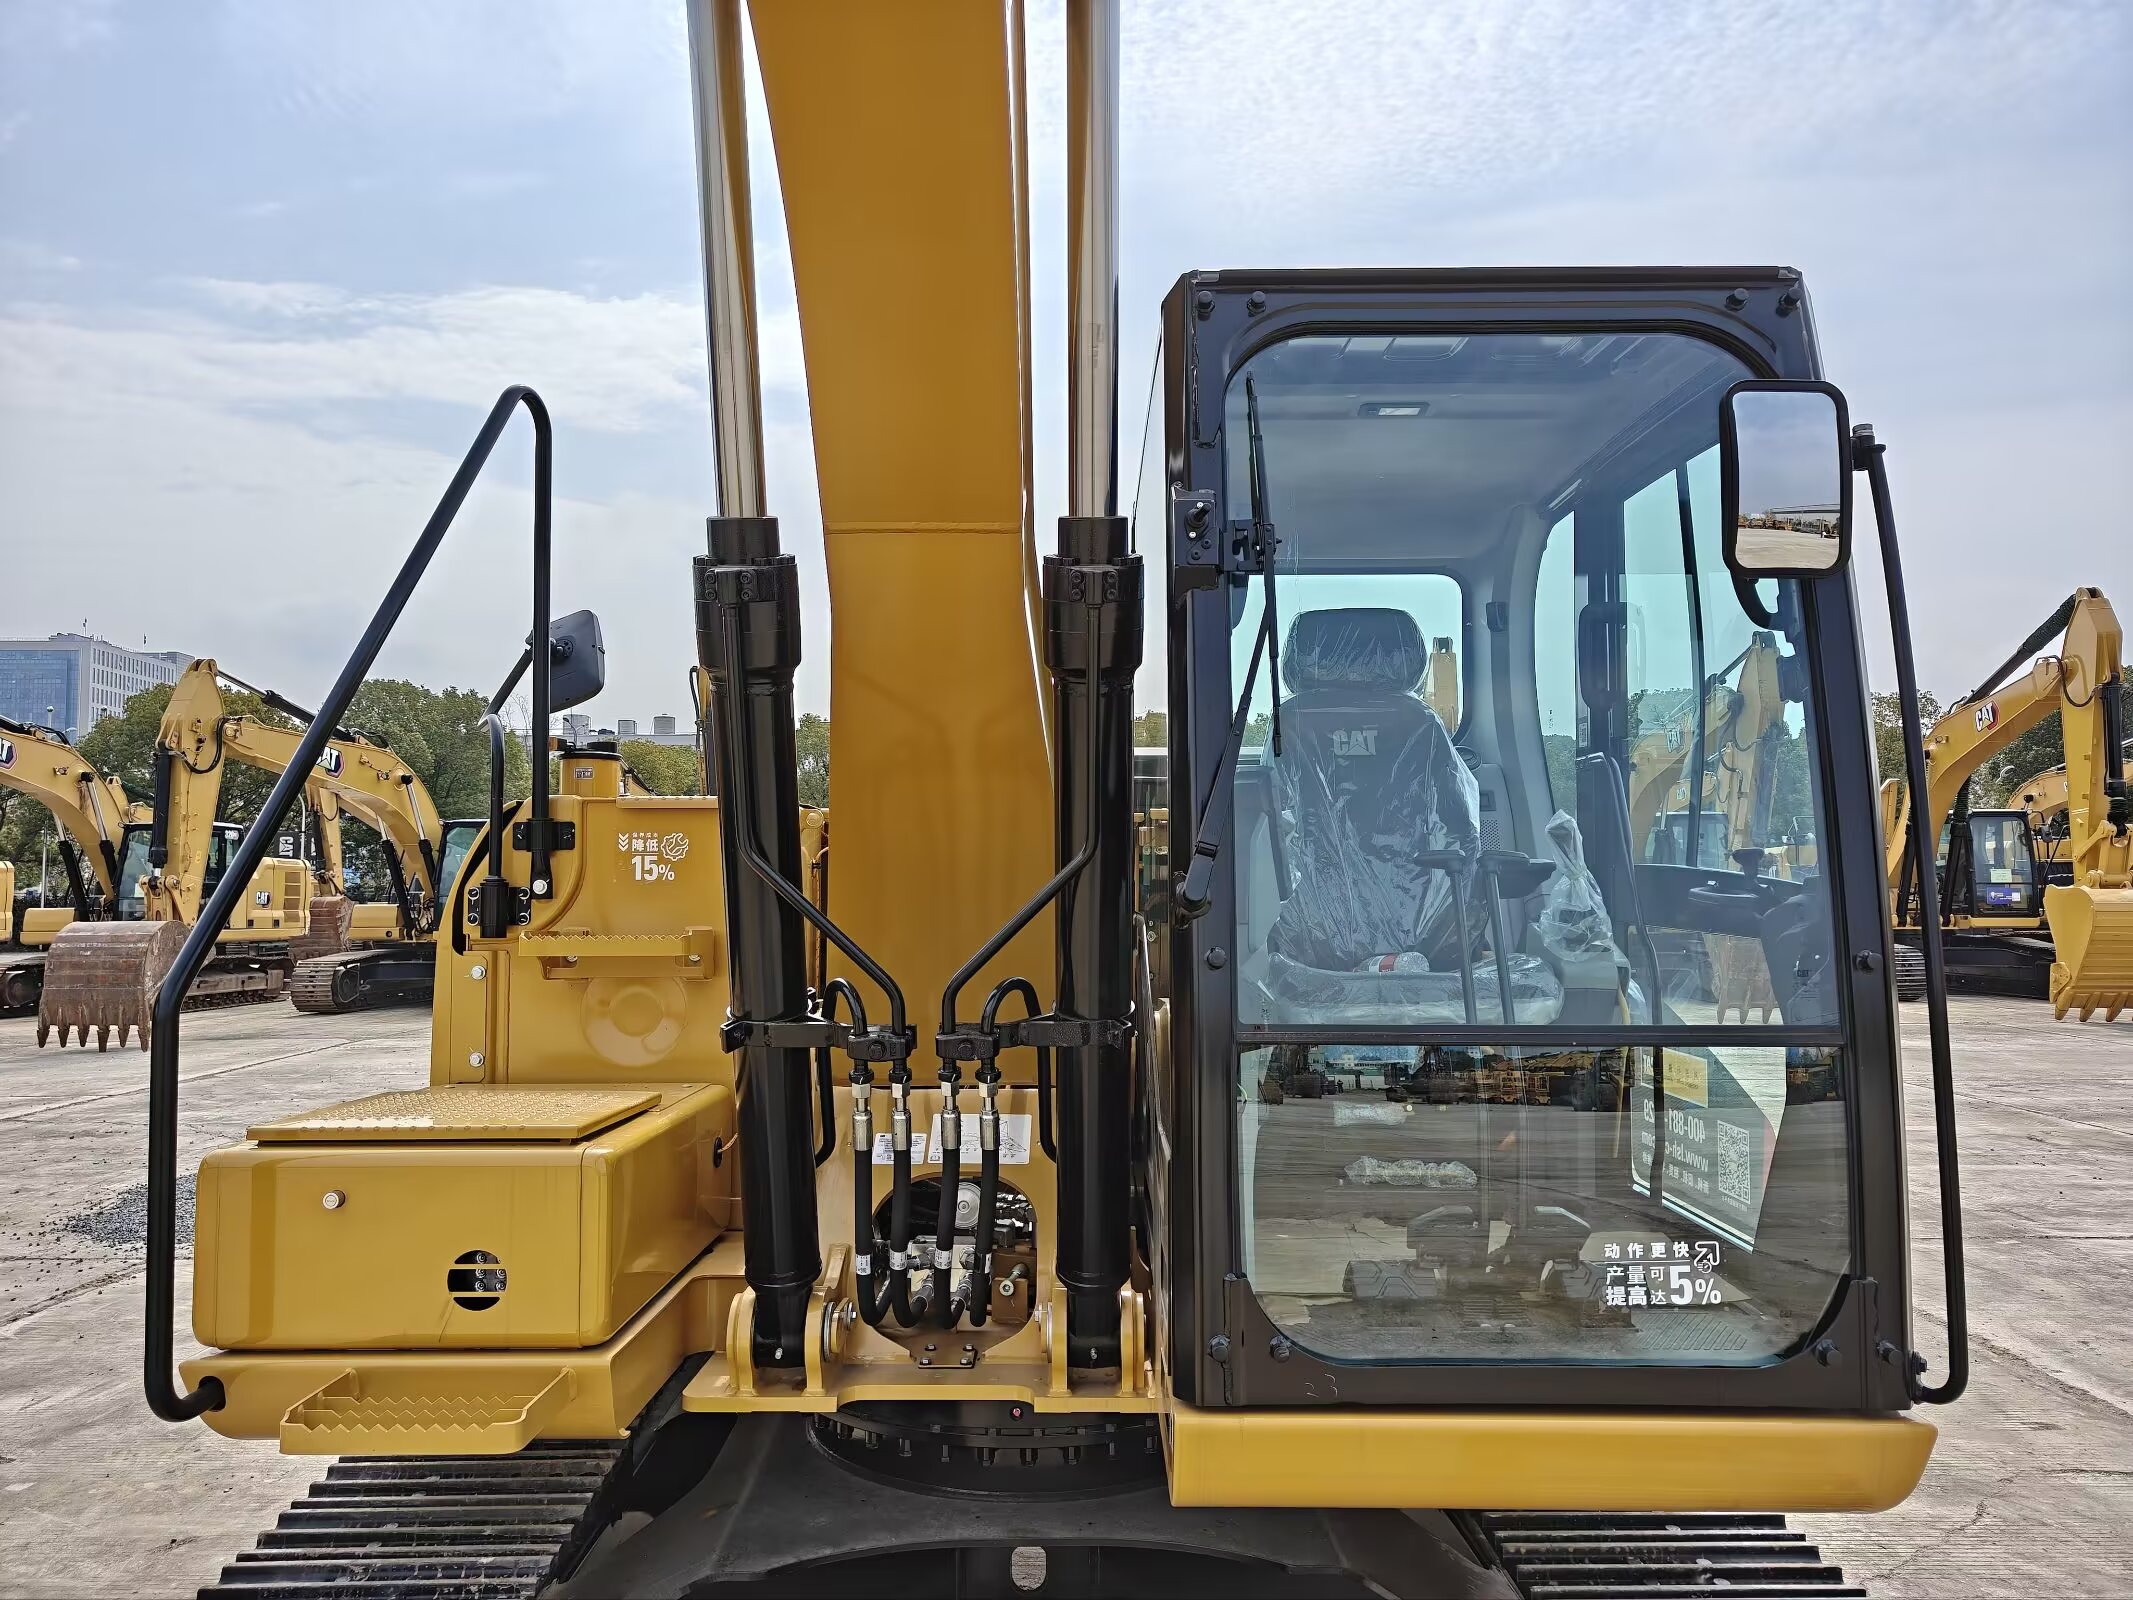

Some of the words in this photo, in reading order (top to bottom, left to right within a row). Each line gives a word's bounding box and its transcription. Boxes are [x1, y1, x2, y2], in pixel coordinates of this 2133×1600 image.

[1975, 703, 1994, 732] CAT
[1333, 730, 1378, 756] CAT
[316, 746, 339, 771] AT
[279, 836, 294, 857] CAT
[632, 838, 659, 852] 降低
[631, 855, 675, 881] 15%
[256, 891, 269, 905] CAT
[1604, 1242, 1690, 1259] 动作更快
[1669, 1265, 1722, 1306] 5%
